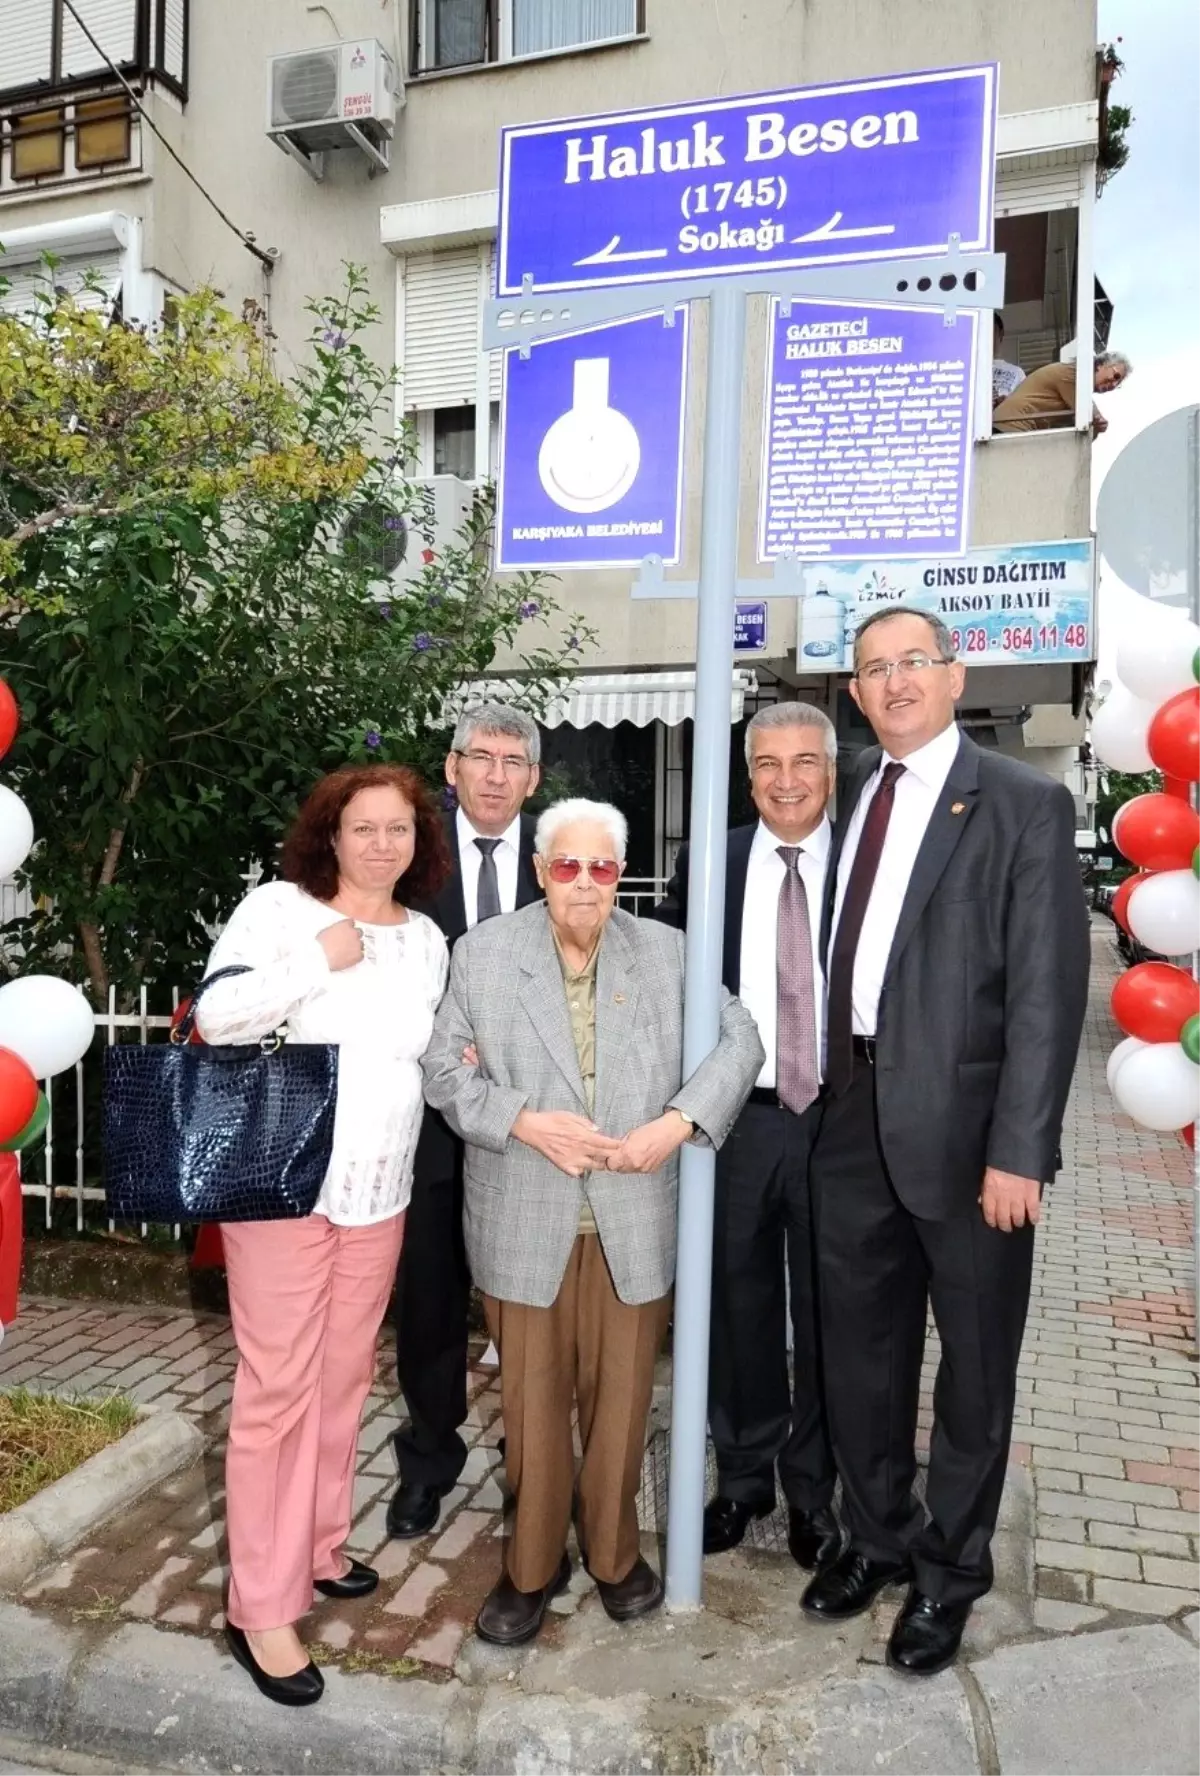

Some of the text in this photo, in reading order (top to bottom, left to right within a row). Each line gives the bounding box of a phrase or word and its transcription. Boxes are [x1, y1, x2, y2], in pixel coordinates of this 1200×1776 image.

[565, 110, 920, 184] Haluk Besen
[681, 175, 788, 220] (1745)
[678, 217, 785, 254] Sokağı
[786, 316, 868, 341] GAZETECİ
[785, 336, 904, 359] HALUK BESEN
[512, 519, 664, 541] KARŞIYAKA BELEDİYESİ
[923, 559, 1067, 587] GİNSU DAĞITIM
[938, 594, 995, 613] AKSOY
[967, 629, 987, 652] 28
[1002, 626, 1034, 651] 364
[1039, 625, 1059, 649] 11
[1065, 623, 1087, 649] 48
